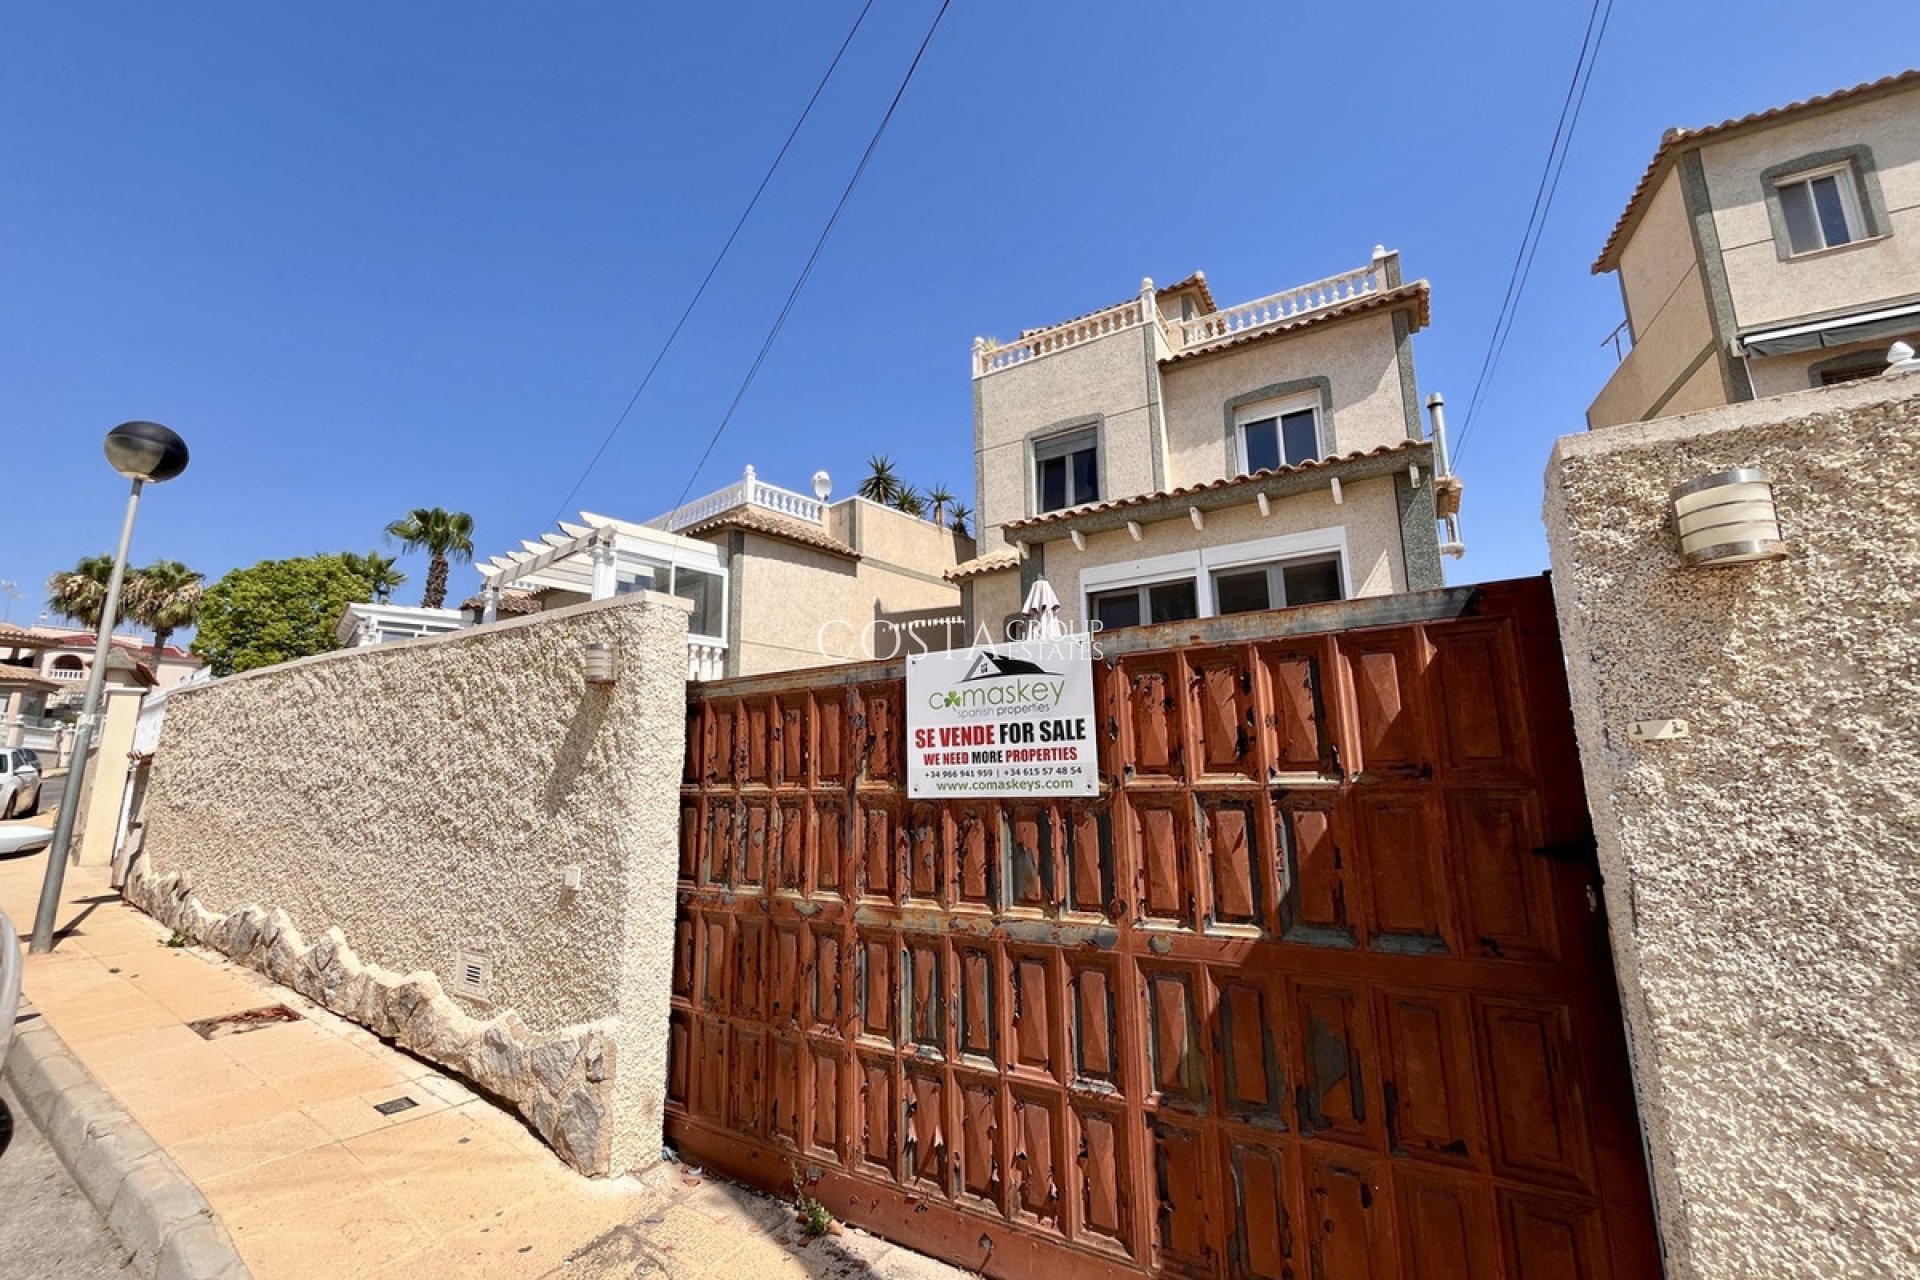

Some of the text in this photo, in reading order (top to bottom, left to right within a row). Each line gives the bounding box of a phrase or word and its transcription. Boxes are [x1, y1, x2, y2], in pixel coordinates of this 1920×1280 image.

[957, 703, 1050, 718] spanish properties
[915, 718, 1086, 749] SE VENDE FOR SALE
[923, 747, 1078, 766] WE NEED MORE PROPERTIES
[1004, 768, 1021, 776] +34
[1023, 767, 1040, 776] 615
[1042, 767, 1053, 776] 57
[1056, 767, 1068, 775] 48
[1070, 766, 1083, 775] 54
[936, 779, 1074, 793] www.comaskeys.com
